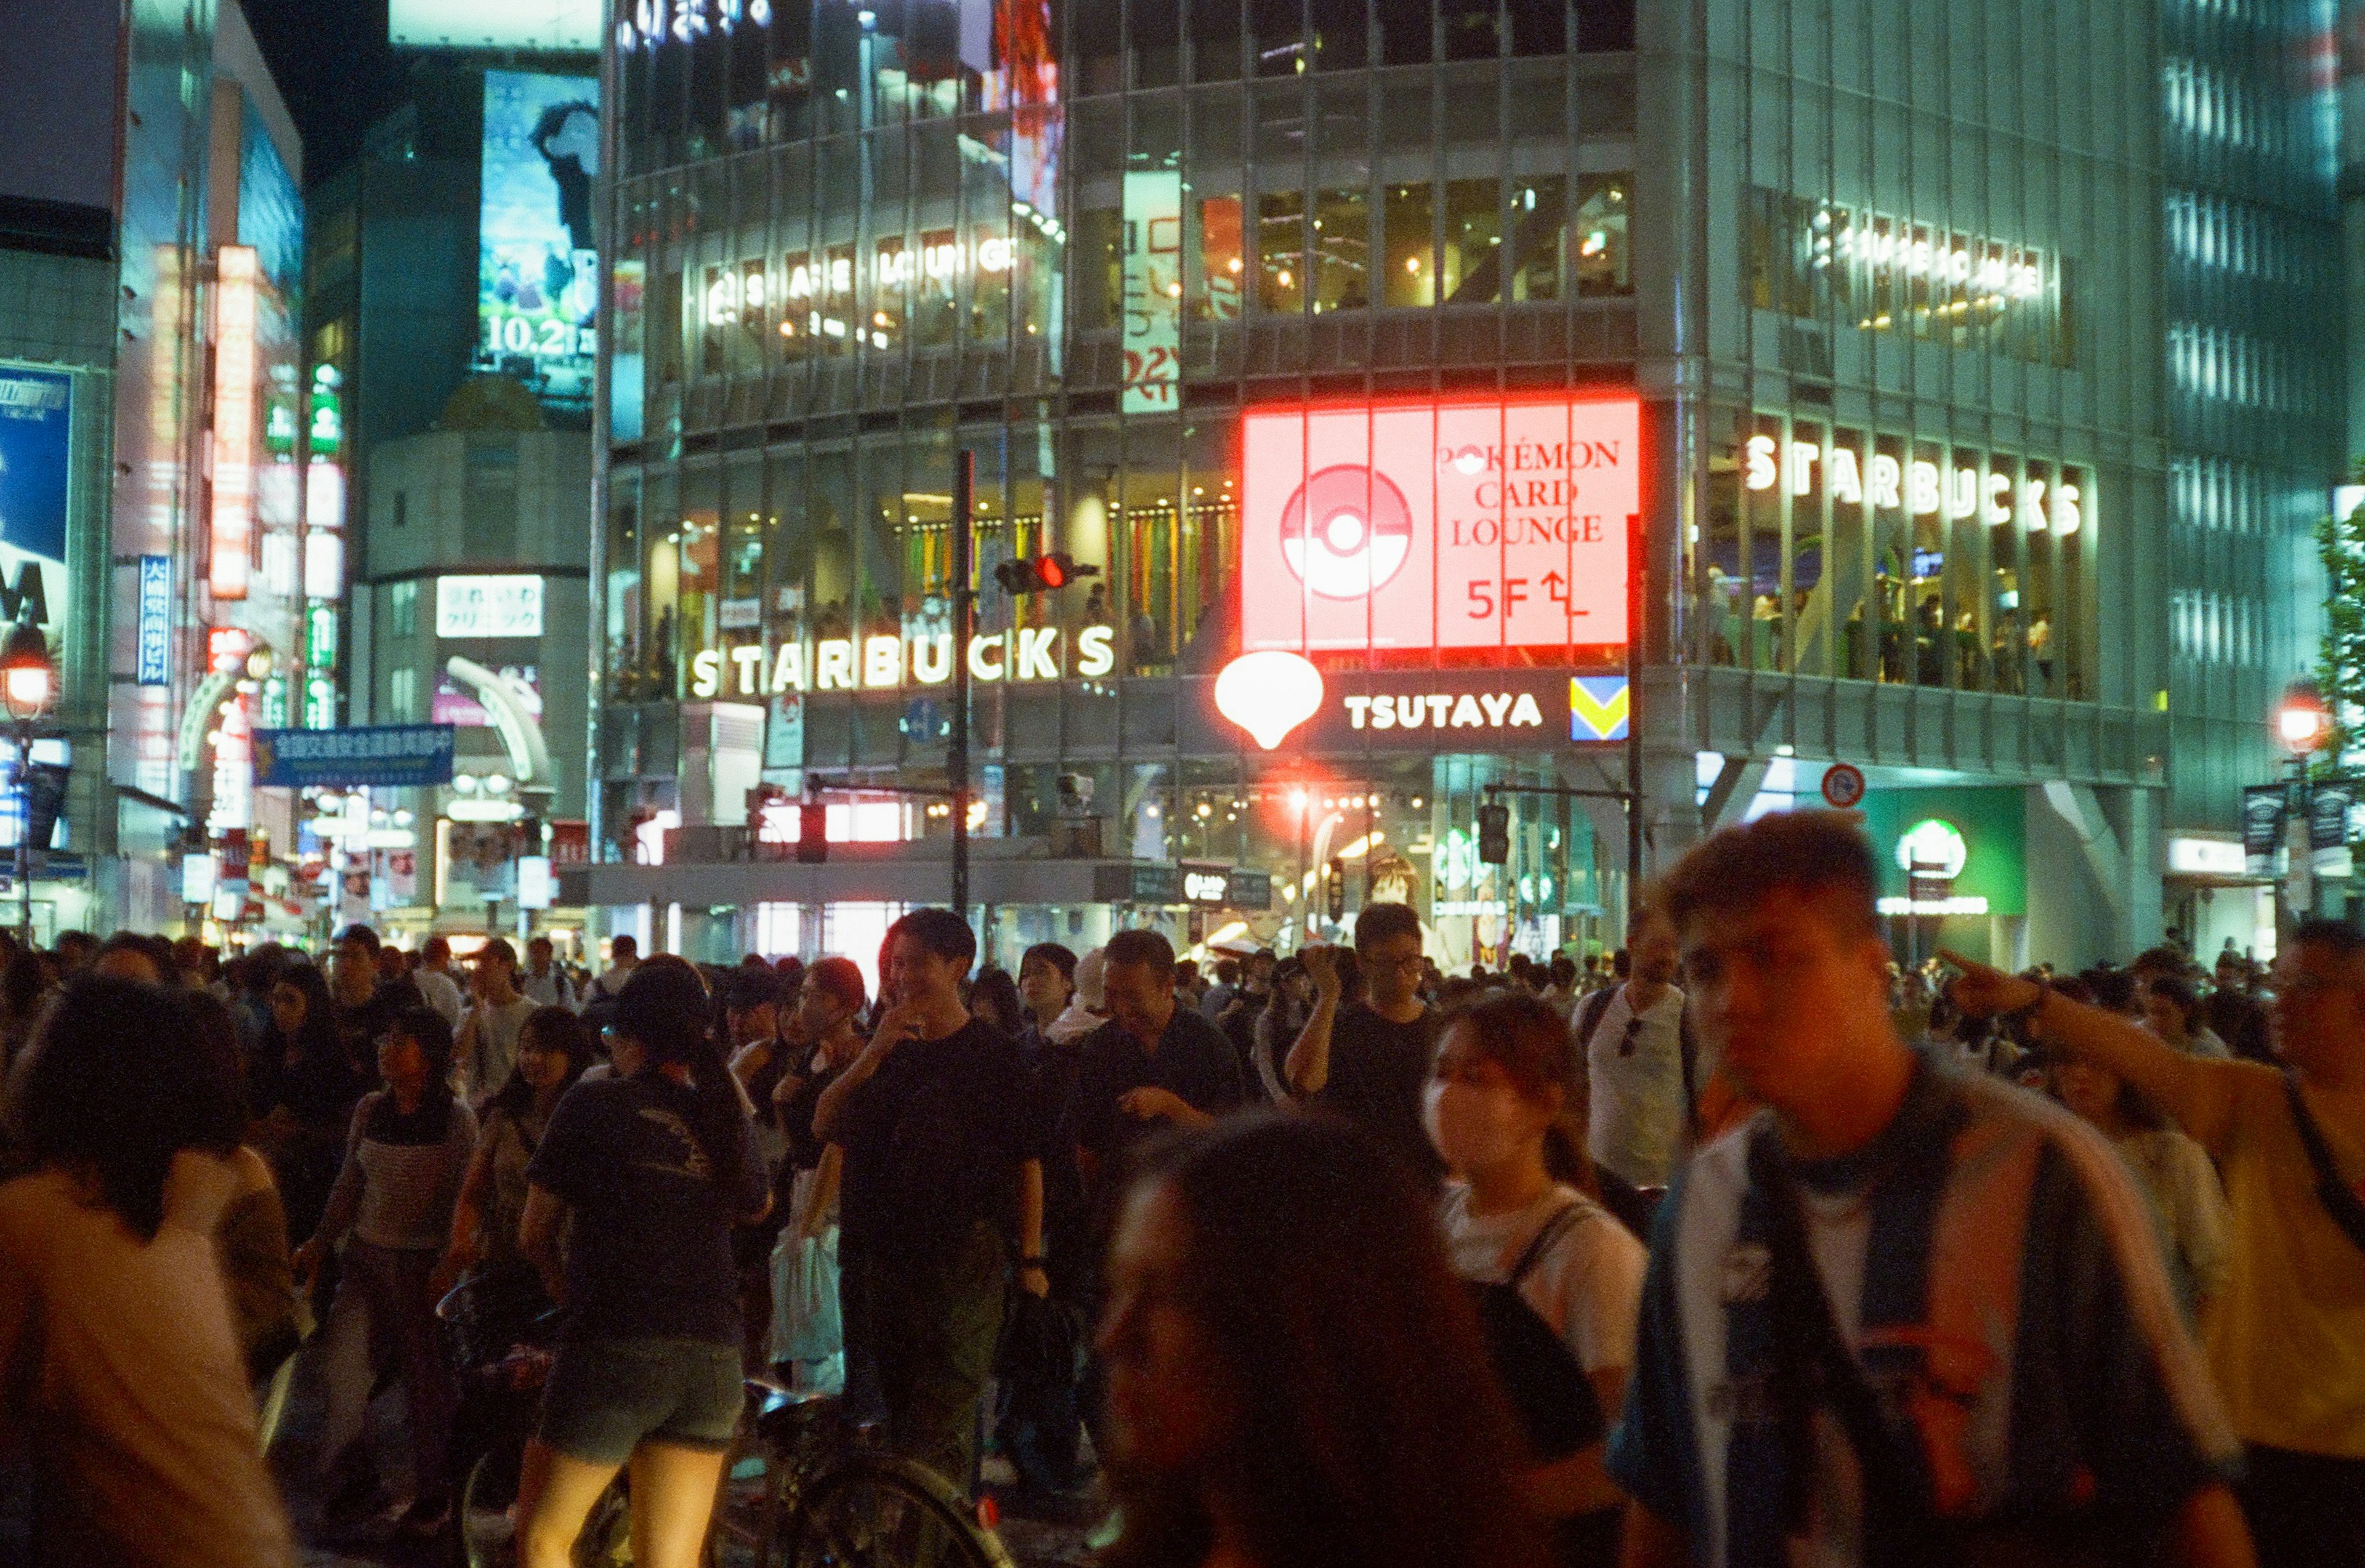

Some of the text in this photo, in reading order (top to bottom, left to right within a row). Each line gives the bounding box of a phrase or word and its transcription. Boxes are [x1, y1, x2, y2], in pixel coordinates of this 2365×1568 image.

[1474, 479, 1579, 510] CARD
[1745, 434, 2080, 535] STARBUCKS
[1452, 514, 1603, 546] LOUNGE
[1467, 578, 1528, 620] 5F
[692, 625, 1115, 697] STARBUCKS
[1344, 693, 1543, 729] TSUTAYA
